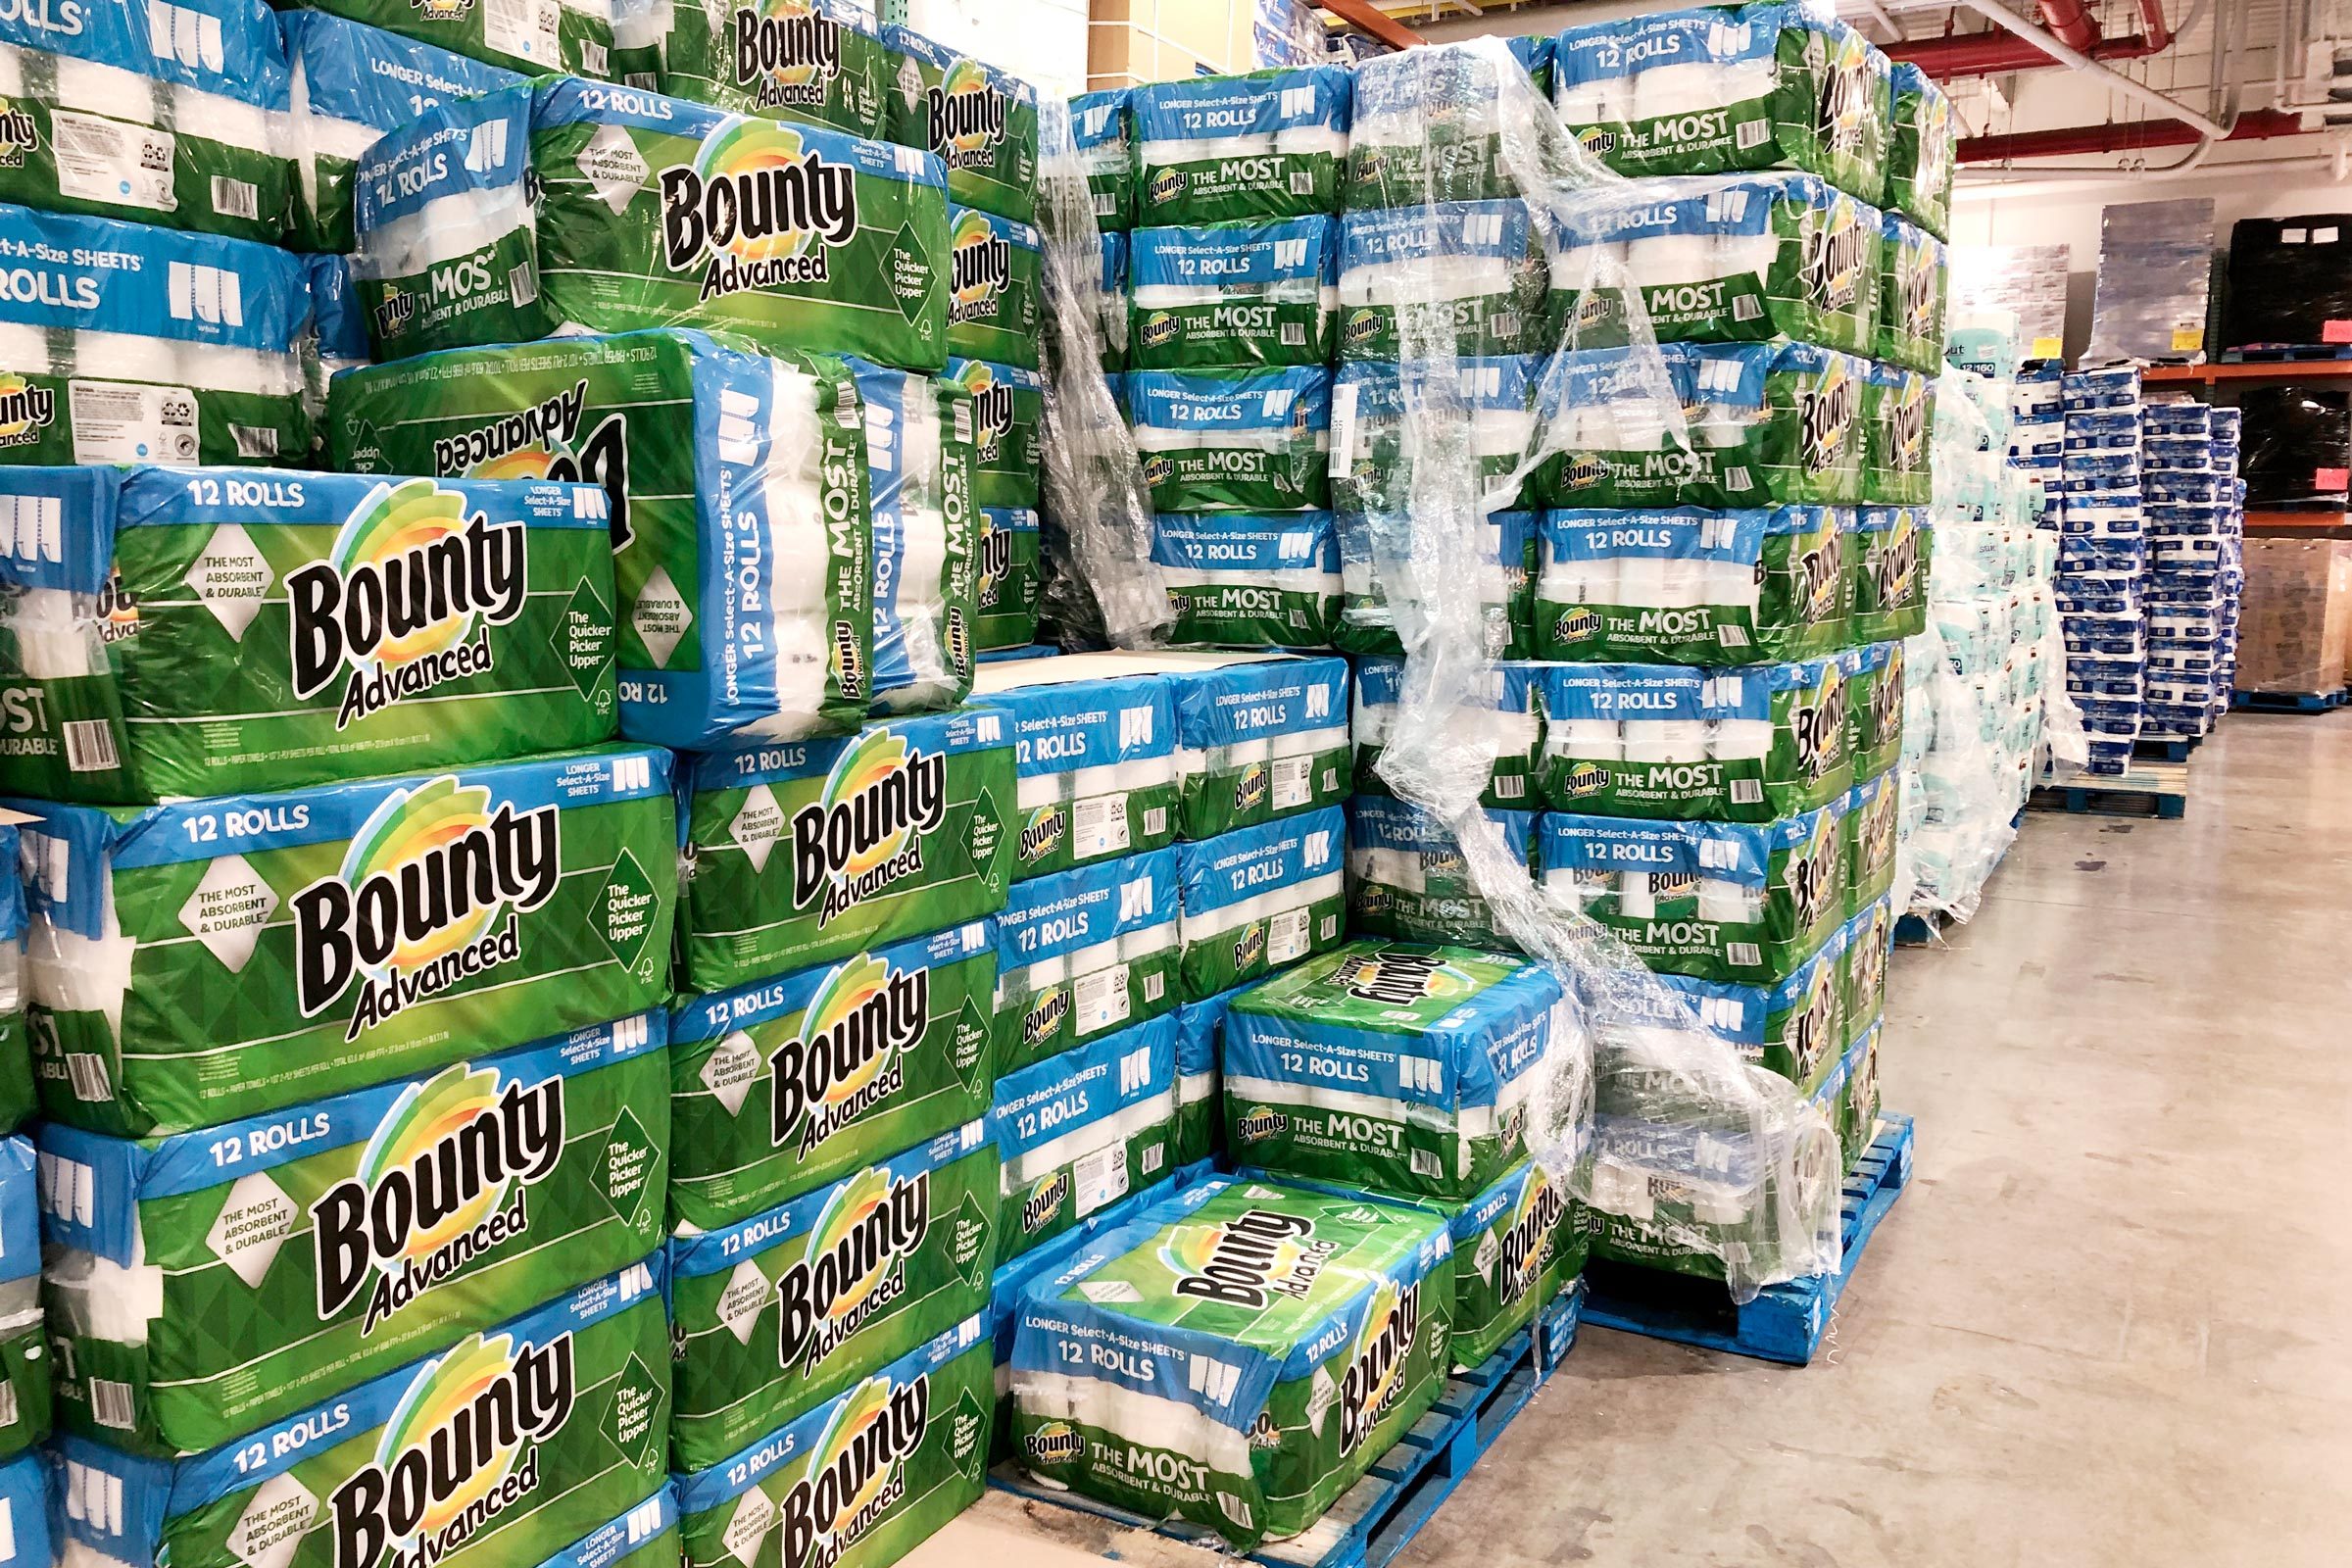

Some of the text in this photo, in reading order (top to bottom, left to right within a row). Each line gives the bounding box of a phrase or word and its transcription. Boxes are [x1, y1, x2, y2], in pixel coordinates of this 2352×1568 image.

[736, 8, 840, 84] Bounty
[1595, 49, 1619, 68] 12
[578, 89, 673, 121] 12 ROLLS
[927, 85, 1005, 152] Bounty
[1183, 108, 1256, 128] 12 ROLLS
[1653, 111, 1730, 143] MOST
[1192, 158, 1285, 185] THE MOST
[660, 154, 858, 272] Bounty
[894, 248, 910, 261] The
[894, 261, 930, 274] Quicker
[1177, 257, 1250, 274] 12 ROLLS
[701, 246, 829, 302] Advanced
[895, 273, 924, 286] Picker
[1650, 283, 1725, 313] MOST
[1184, 306, 1277, 329] THE MOST
[1170, 404, 1242, 421] 12 ROLLS
[1178, 452, 1266, 472] THE MOST
[1614, 464, 1641, 477] THE
[192, 480, 305, 508] 12 ROLLS
[825, 439, 854, 612] THE MOST
[1162, 530, 1246, 542] LONGER Select-A-Size
[1557, 516, 1659, 529] LONGER Select-A-Size
[1186, 544, 1257, 561] 12 ROLLS
[1586, 529, 1671, 549] 12 ROLLS
[205, 556, 254, 567] THE MOST
[207, 571, 264, 584] ABSORBENT
[739, 512, 764, 659] 12 ROLLS
[284, 514, 525, 699] Bounty
[1195, 589, 1282, 610] THE MOST
[568, 611, 589, 626] The
[569, 624, 612, 639] Quicker
[1607, 609, 1710, 633] THE MOST
[569, 639, 604, 653] Picker
[1607, 633, 1657, 644] ABSORBENT
[836, 621, 860, 699] Bounty
[335, 627, 492, 729] Advanced
[1591, 692, 1677, 710] 12 ROLLS
[1233, 706, 1287, 729] 12 ROLLS
[1036, 732, 1086, 759] ROLLS
[735, 748, 807, 774] 12 ROLLS
[1615, 765, 1723, 787] THE MOST
[1615, 788, 1667, 799] ABSORBENT
[182, 806, 310, 844] 12 ROLLS
[741, 816, 779, 832] ABSORBENT
[793, 748, 946, 910] Bounty
[973, 823, 999, 834] Quicker
[1020, 812, 1065, 859] Bounty
[972, 835, 994, 847] Picker
[1585, 843, 1674, 863] 12 ROLLS
[607, 884, 630, 898] The
[817, 838, 922, 930] Advanced
[1231, 871, 1247, 890] 12
[198, 885, 257, 904] THE MOST
[608, 891, 653, 910] Quicker
[199, 898, 268, 919] ABSORBENT
[292, 801, 560, 1016] Bounty
[609, 906, 645, 925] Picker
[1019, 915, 1089, 952] 12 ROLLS
[1646, 924, 1720, 948] MOST
[346, 911, 520, 1040] Advanced
[706, 986, 784, 1024] 12 ROLLS
[1024, 988, 1069, 1037] Bounty
[956, 1031, 983, 1046] Quicker
[956, 1042, 979, 1056] Picker
[1252, 1034, 1355, 1056] LONGER Select-A-Size
[771, 965, 930, 1148] Bounty
[1280, 1052, 1369, 1082] 12 ROLLS
[798, 1054, 904, 1163] Advanced
[1017, 1097, 1089, 1140] 12 ROLLS
[1237, 1110, 1289, 1138] Bounty
[1294, 1115, 1404, 1149] THE MOST
[210, 1113, 330, 1167] 12 ROLLS
[608, 1140, 629, 1154] The
[1294, 1135, 1348, 1150] ABSORBENT
[610, 1146, 648, 1171] Quicker
[610, 1162, 645, 1185] Picker
[313, 1075, 565, 1320] Bounty
[1022, 1172, 1068, 1226] Bounty
[222, 1199, 278, 1225] THE MOST
[223, 1208, 288, 1240] ABSORBENT
[721, 1213, 790, 1257] 12 ROLLS
[362, 1190, 527, 1337] Advanced
[778, 1172, 929, 1367] Bounty
[1176, 1209, 1314, 1307] Bounty
[804, 1270, 906, 1379] Advanced
[1026, 1316, 1140, 1349] LONGER Select-A-Size
[1058, 1341, 1154, 1383] 12 ROLLS
[617, 1389, 654, 1416] Quicker
[617, 1405, 650, 1428] Picker
[233, 1404, 350, 1474] 12 ROLLS
[1025, 1430, 1086, 1457] Bounty
[727, 1434, 795, 1484] 12 ROLLS
[782, 1373, 929, 1567] Bounty
[1092, 1443, 1210, 1491] THE MOST
[1092, 1461, 1149, 1492] ABSORBENT
[244, 1495, 301, 1529] THE MOST
[246, 1504, 311, 1542] ABSORBENT
